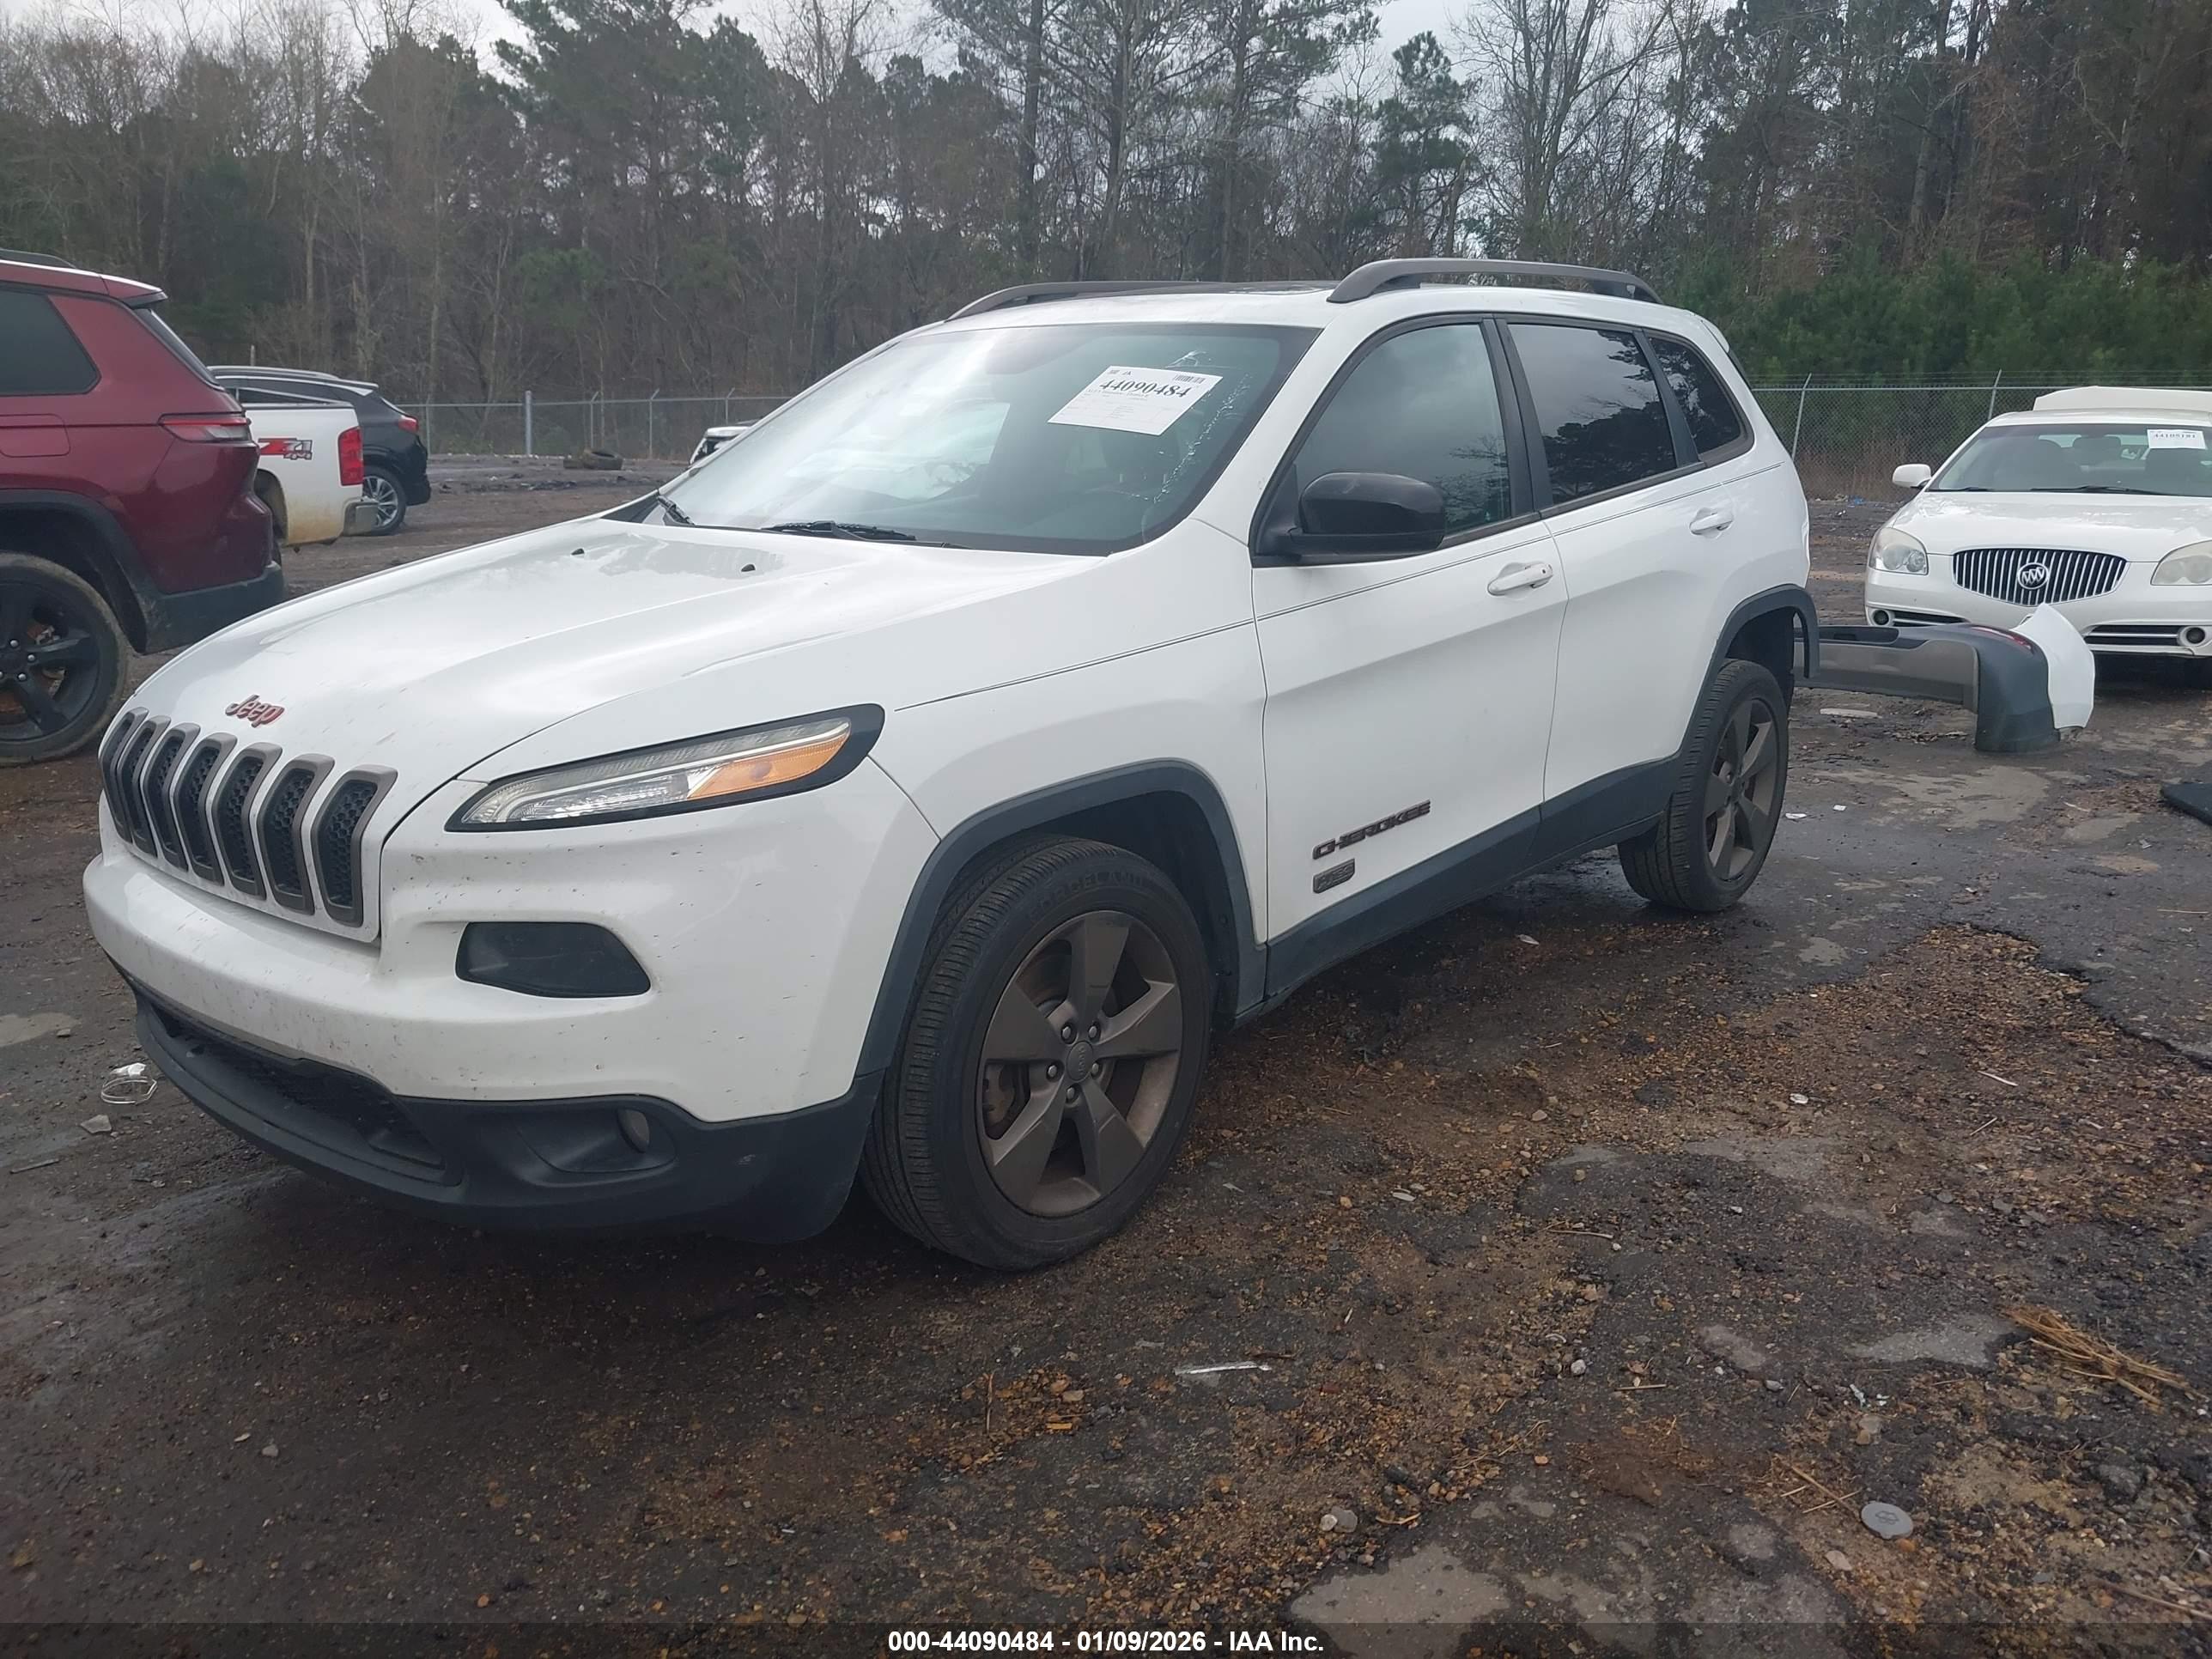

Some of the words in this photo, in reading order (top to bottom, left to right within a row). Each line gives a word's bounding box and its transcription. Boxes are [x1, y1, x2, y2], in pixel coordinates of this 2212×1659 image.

[1099, 379, 1193, 398] 44090484
[225, 694, 285, 728] Jeep
[1313, 799, 1431, 860] CHEROKEE
